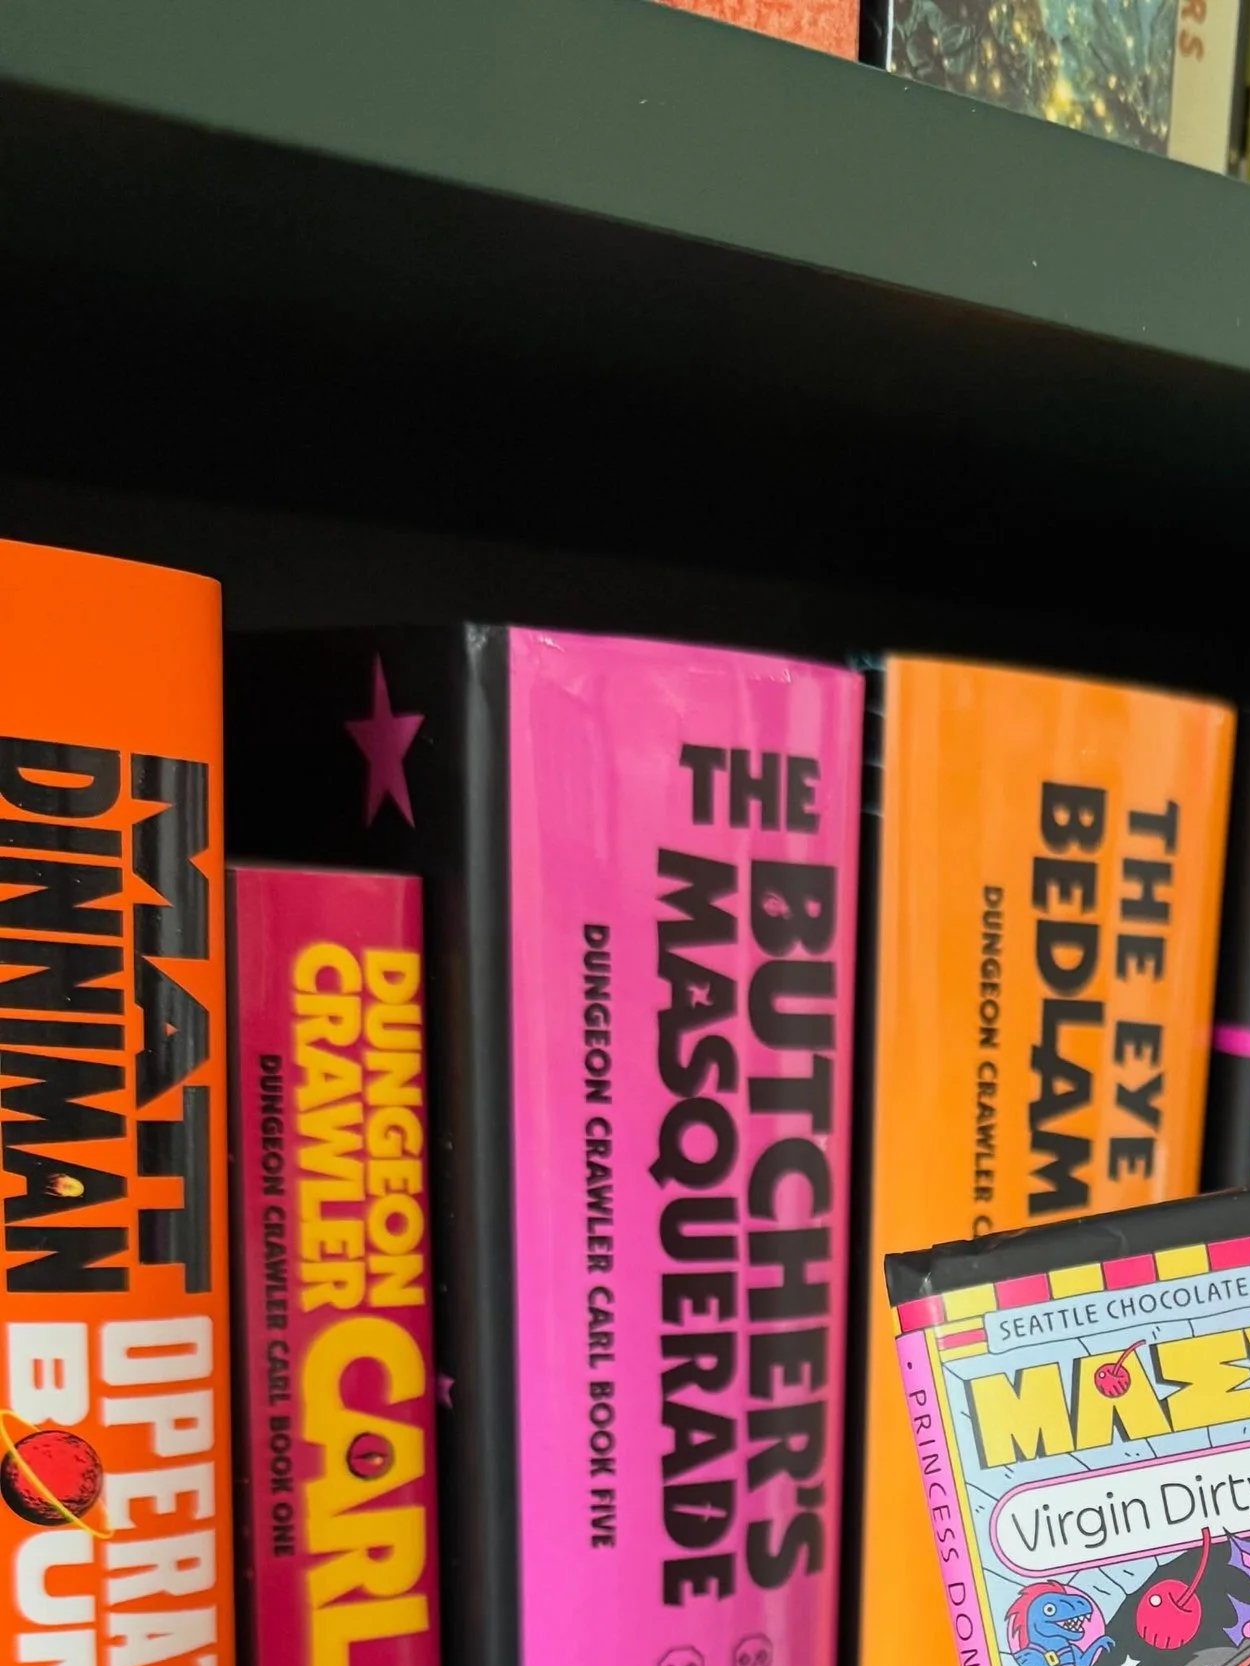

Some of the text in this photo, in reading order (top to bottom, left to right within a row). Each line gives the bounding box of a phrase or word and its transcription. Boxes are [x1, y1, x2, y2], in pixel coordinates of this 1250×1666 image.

[678, 743, 822, 836] THE
[978, 884, 1005, 1050] DUNGEON
[0, 735, 130, 1293] DINNIMAN
[131, 753, 210, 1294] MATT
[293, 941, 365, 1313] CRAWLER
[364, 949, 425, 1307] DUNGEON
[971, 1060, 1000, 1204] CRAWLER
[1027, 780, 1108, 1219] BEDLAM
[1107, 799, 1181, 1184] THE EYE
[256, 1054, 292, 1558] DUNGEON CRAWLER CARL BOOK ONE
[582, 924, 617, 1550] DUNGEON CRAWLER CARL BOOK FIVE
[649, 848, 739, 1608] MASQUERADE
[743, 858, 838, 1591] BUTCHER'S
[999, 1303, 1099, 1341] SEATTLE
[1107, 1279, 1249, 1331] CHOCOLATE
[909, 1388, 962, 1564] PRINCESS
[1011, 1484, 1149, 1554] Virgin
